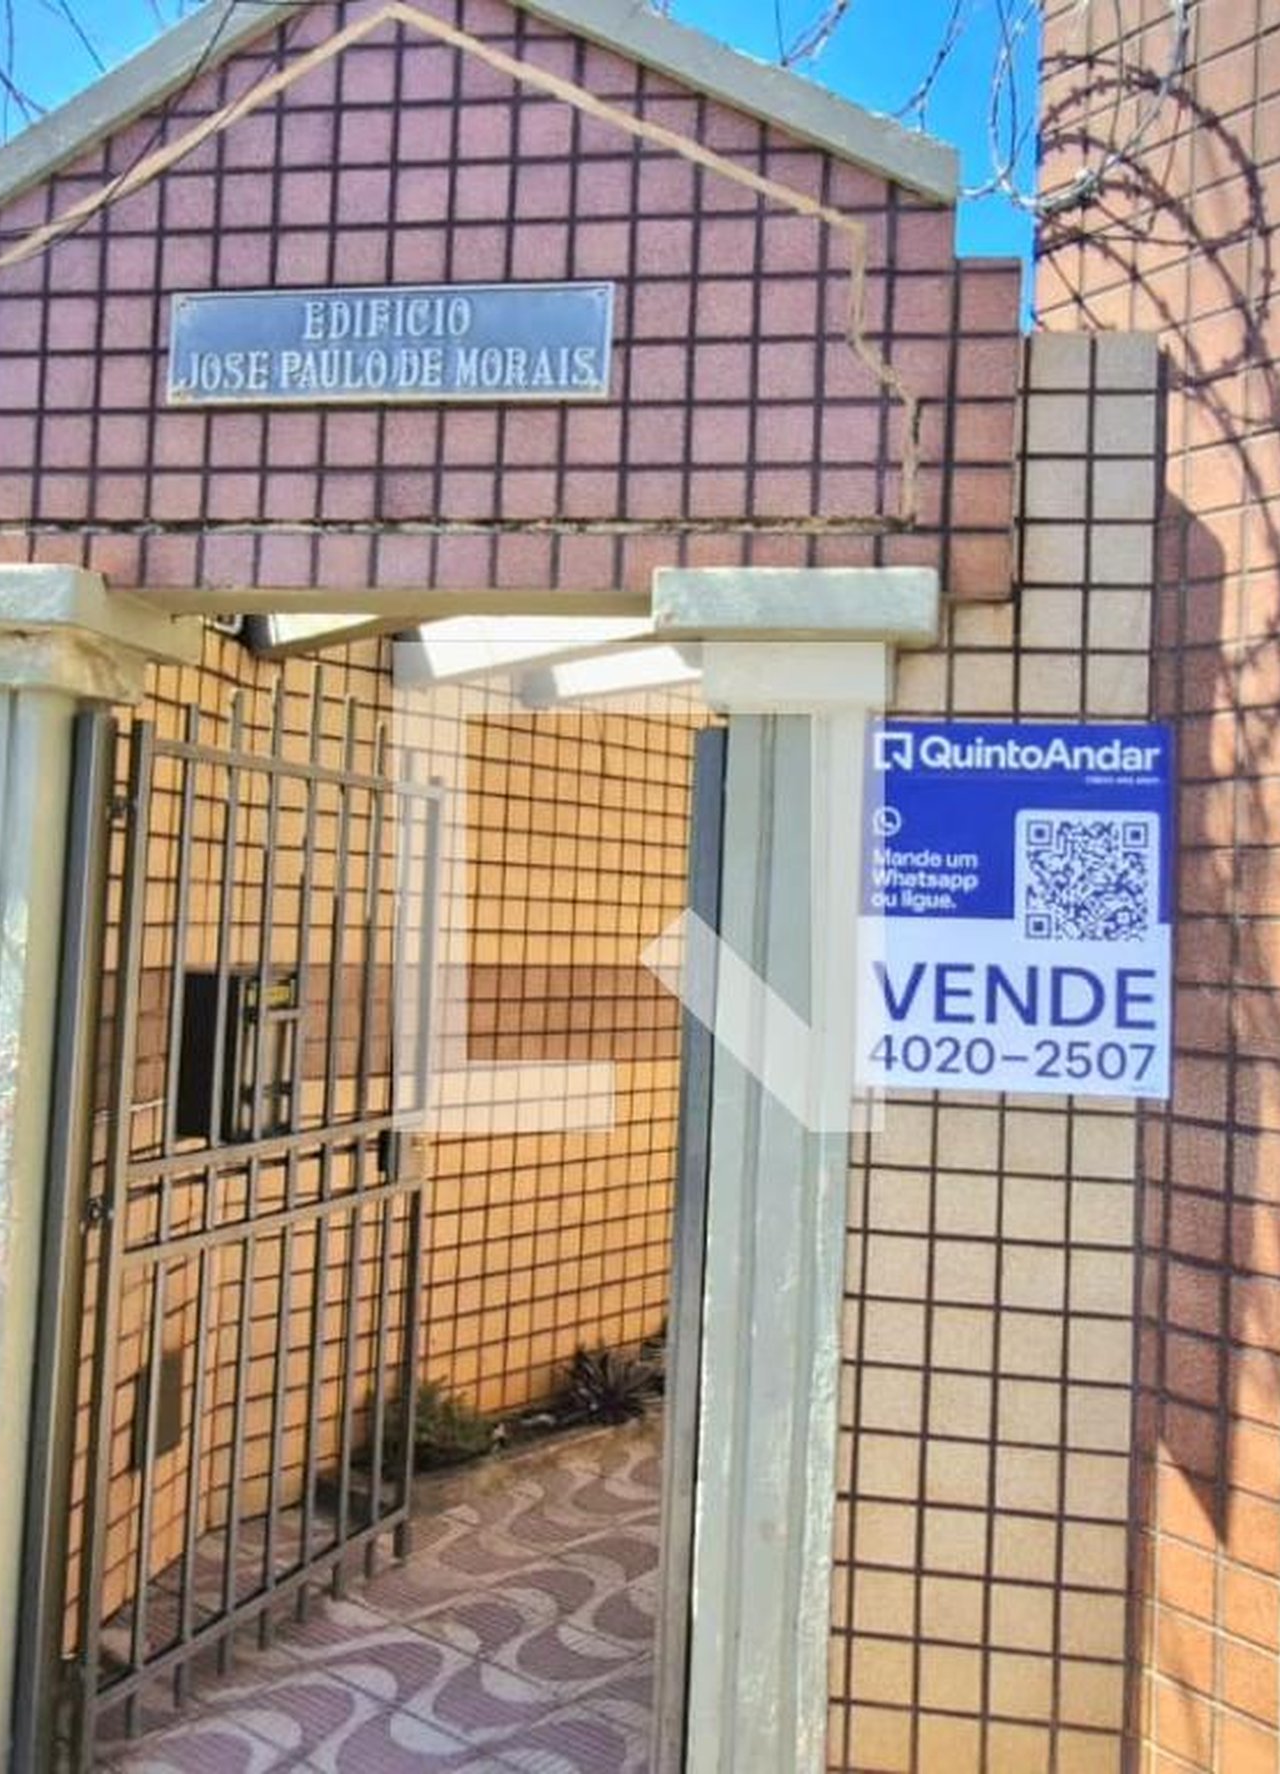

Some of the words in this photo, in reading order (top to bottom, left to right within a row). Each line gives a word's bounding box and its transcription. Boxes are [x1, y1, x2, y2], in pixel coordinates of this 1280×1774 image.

[304, 298, 472, 341] EDIFICIO
[177, 350, 270, 391] JOSE
[279, 348, 388, 390] PAULO
[397, 347, 443, 387] DE
[456, 345, 599, 386] MORAIS
[919, 735, 1161, 772] QuintoAndar
[873, 849, 942, 867] Mande
[945, 851, 979, 868] um
[871, 869, 979, 893] Whatsapp
[871, 893, 898, 909] ou
[900, 888, 958, 914] ligue.
[873, 960, 1157, 1031] VENDE
